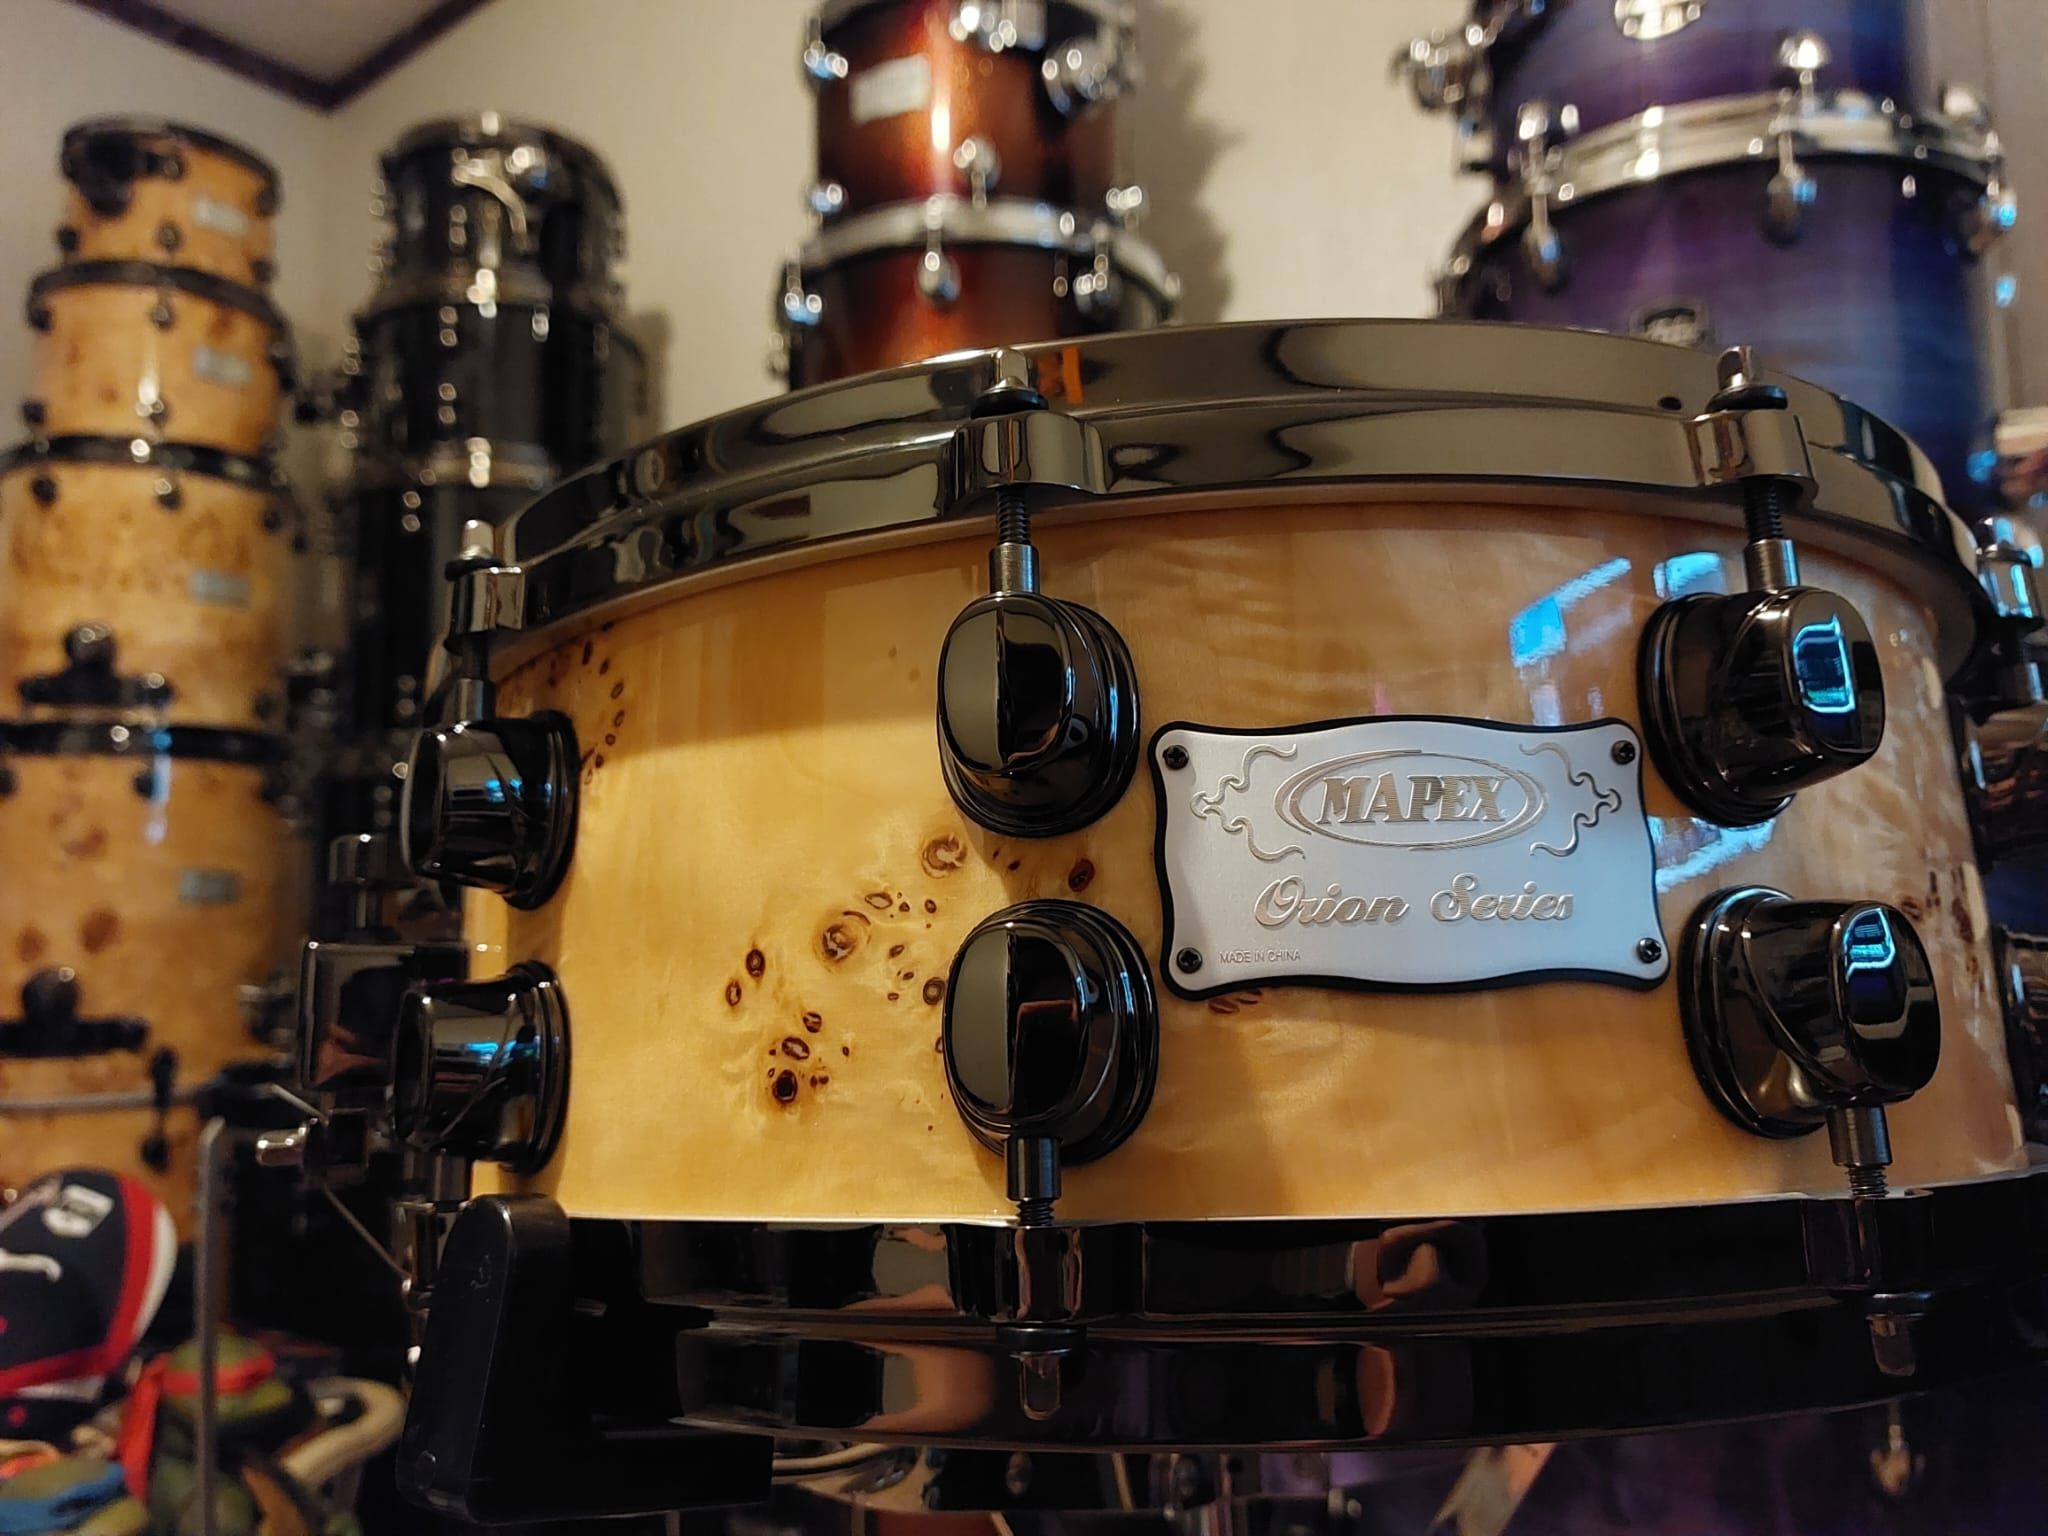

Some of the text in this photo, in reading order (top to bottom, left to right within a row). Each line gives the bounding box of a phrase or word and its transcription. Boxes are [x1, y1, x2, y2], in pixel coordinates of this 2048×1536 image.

[1316, 773, 1506, 825] MAPEX
[1253, 872, 1574, 926] Orion Series
[1219, 948, 1301, 964] MADE IN CHINA
